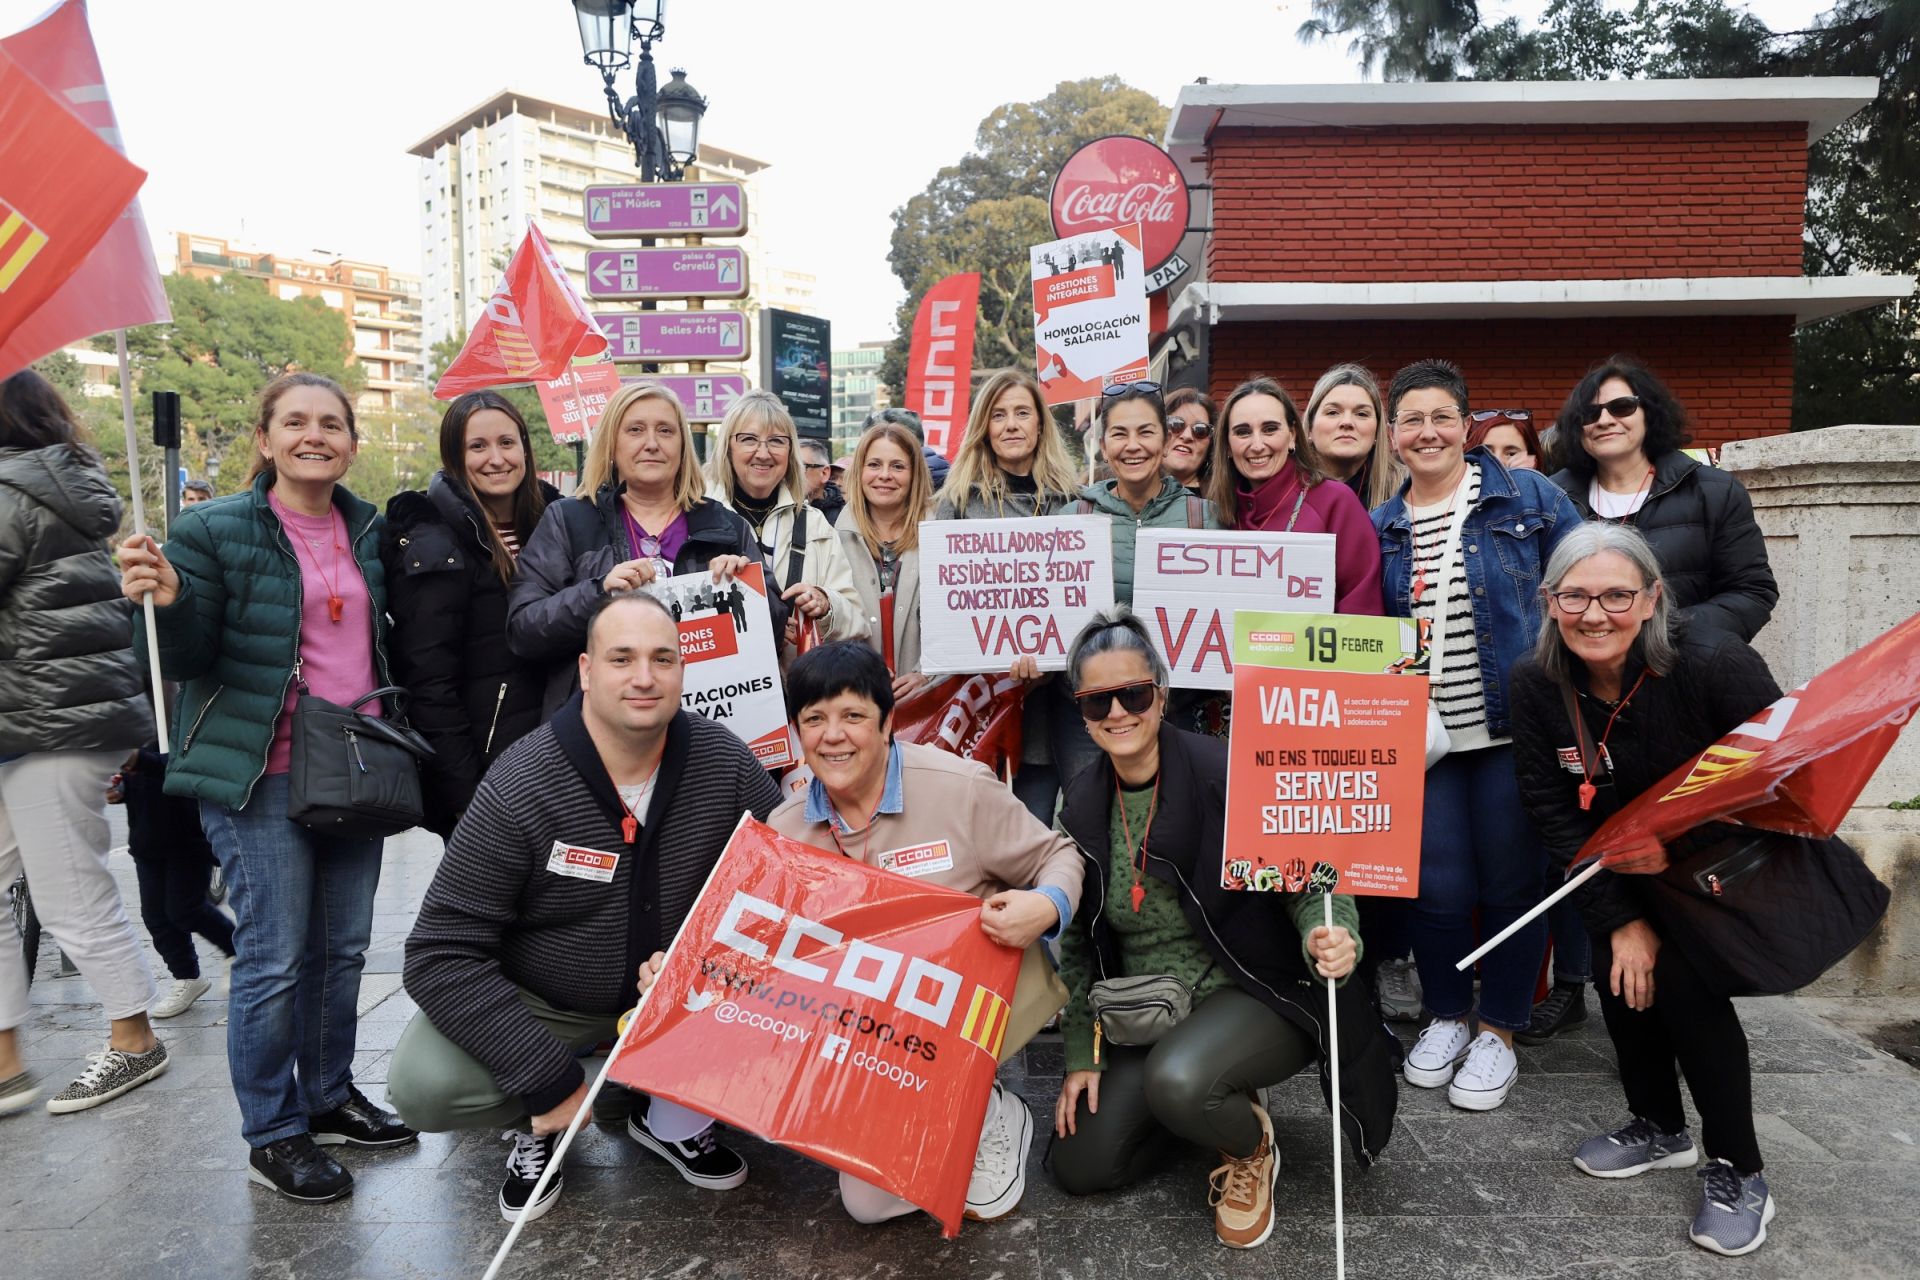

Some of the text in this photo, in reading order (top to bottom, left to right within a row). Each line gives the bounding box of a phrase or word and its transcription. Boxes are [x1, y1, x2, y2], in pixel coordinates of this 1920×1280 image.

[612, 191, 633, 199] palau
[612, 199, 661, 208] la Música
[1061, 183, 1179, 225] Coca-Cola
[682, 253, 703, 261] palau
[1153, 256, 1186, 287] PAZ
[1049, 275, 1098, 292] GESTIONES
[1046, 285, 1098, 302] INTEGRALES
[660, 325, 717, 335] Belles Arts
[1044, 314, 1141, 340] HOMOLOGACIÓN
[1064, 331, 1121, 347] SALARIAL
[922, 301, 960, 455] CCOO
[1114, 372, 1138, 383] CCOO
[1157, 543, 1323, 599] ESTEM DE
[947, 585, 1087, 611] CONCERTADES EN
[679, 627, 714, 643] ONES
[971, 613, 1066, 656] VAGA
[1155, 606, 1234, 674] VA
[1251, 633, 1281, 642] CCOO
[681, 639, 716, 655] RALES
[1305, 626, 1383, 663] 19 FEBRER
[681, 676, 773, 707] TACIONES
[1259, 685, 1341, 728] VAGA
[1371, 698, 1380, 706] de
[1380, 698, 1409, 706] diversitat
[1344, 708, 1372, 716] funcional
[1377, 708, 1401, 716] infància
[1347, 718, 1387, 726] adolescència
[753, 745, 774, 756] COO
[1256, 749, 1397, 766] NO ENS TOQUEU ELS
[1275, 771, 1378, 800] SERVEIS
[1262, 804, 1391, 834] SOCIALS!!!
[568, 852, 602, 865] CCOO
[898, 848, 933, 863] CCOO
[712, 889, 964, 1029] CCOO
[714, 1001, 813, 1044] @ccoopv
[852, 1050, 929, 1093] ccoopv
